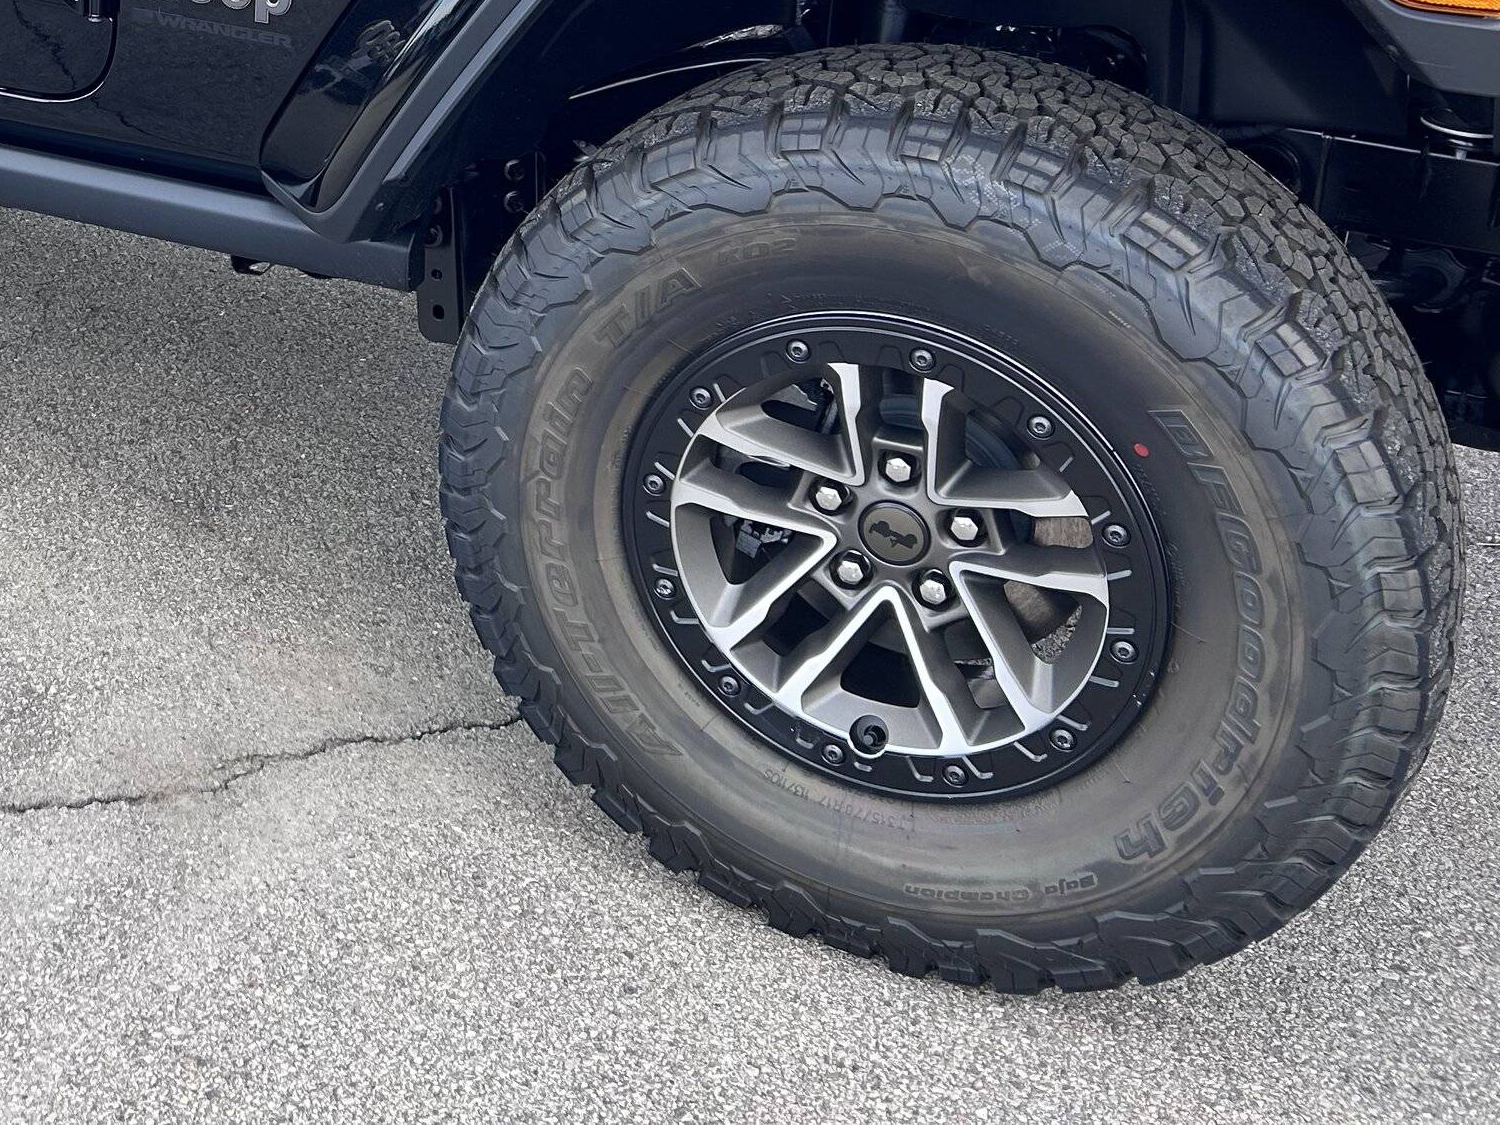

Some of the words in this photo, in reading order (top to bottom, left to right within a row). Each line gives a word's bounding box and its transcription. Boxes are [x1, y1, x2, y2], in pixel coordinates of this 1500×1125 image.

[156, 11, 293, 48] WRANGLER
[903, 882, 1032, 902] Champion
[1043, 872, 1098, 896] Baja
